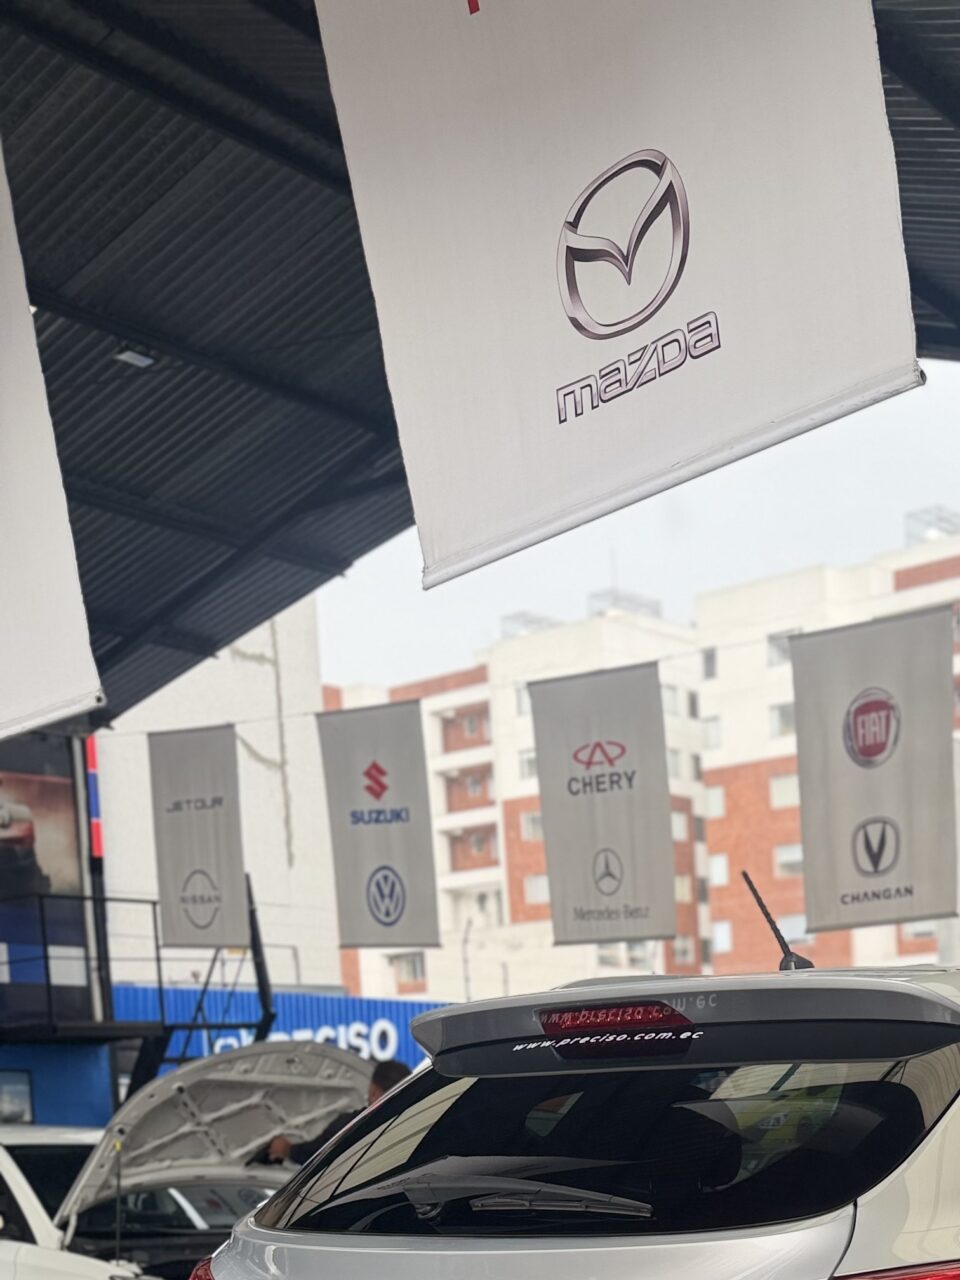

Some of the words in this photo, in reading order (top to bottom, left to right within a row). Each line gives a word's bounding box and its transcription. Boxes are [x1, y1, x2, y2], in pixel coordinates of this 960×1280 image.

[856, 709, 891, 746] FIAT
[567, 769, 636, 796] CHERY
[166, 797, 224, 813] JETOUR
[350, 807, 410, 826] SUZUKI
[840, 885, 914, 906] CHANGAN
[513, 1030, 704, 1051] www.preciso.com.ec
